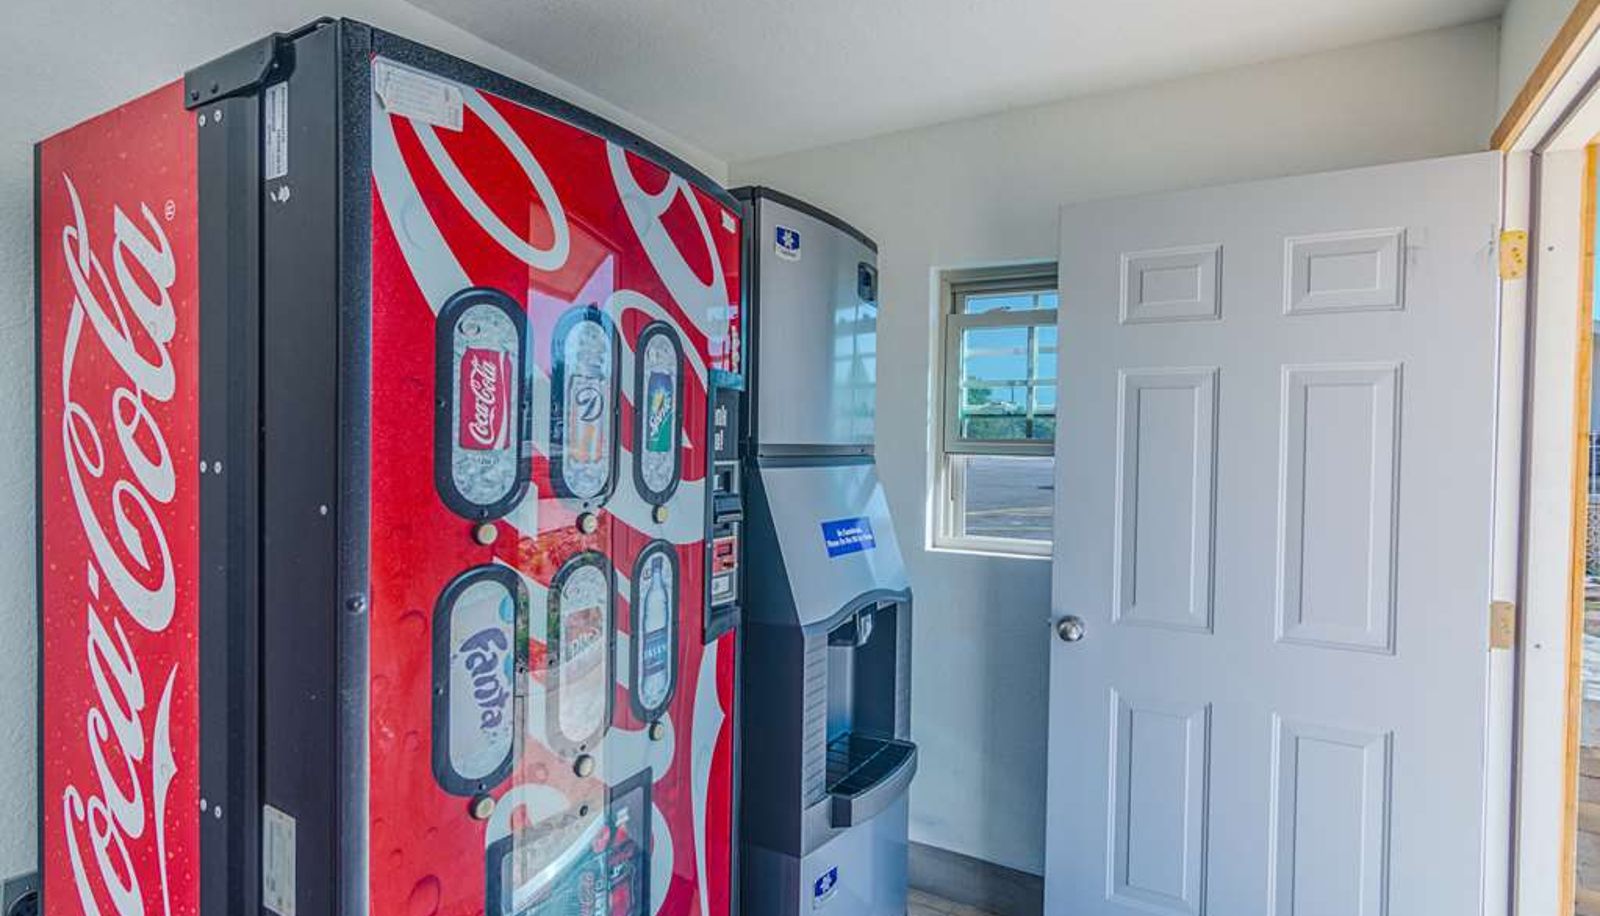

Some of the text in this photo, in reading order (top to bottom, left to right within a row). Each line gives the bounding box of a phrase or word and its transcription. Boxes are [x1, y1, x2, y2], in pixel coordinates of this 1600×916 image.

[468, 354, 497, 445] Coca-Cola
[62, 171, 178, 916] Coca-Cola
[459, 627, 510, 730] Fanta
